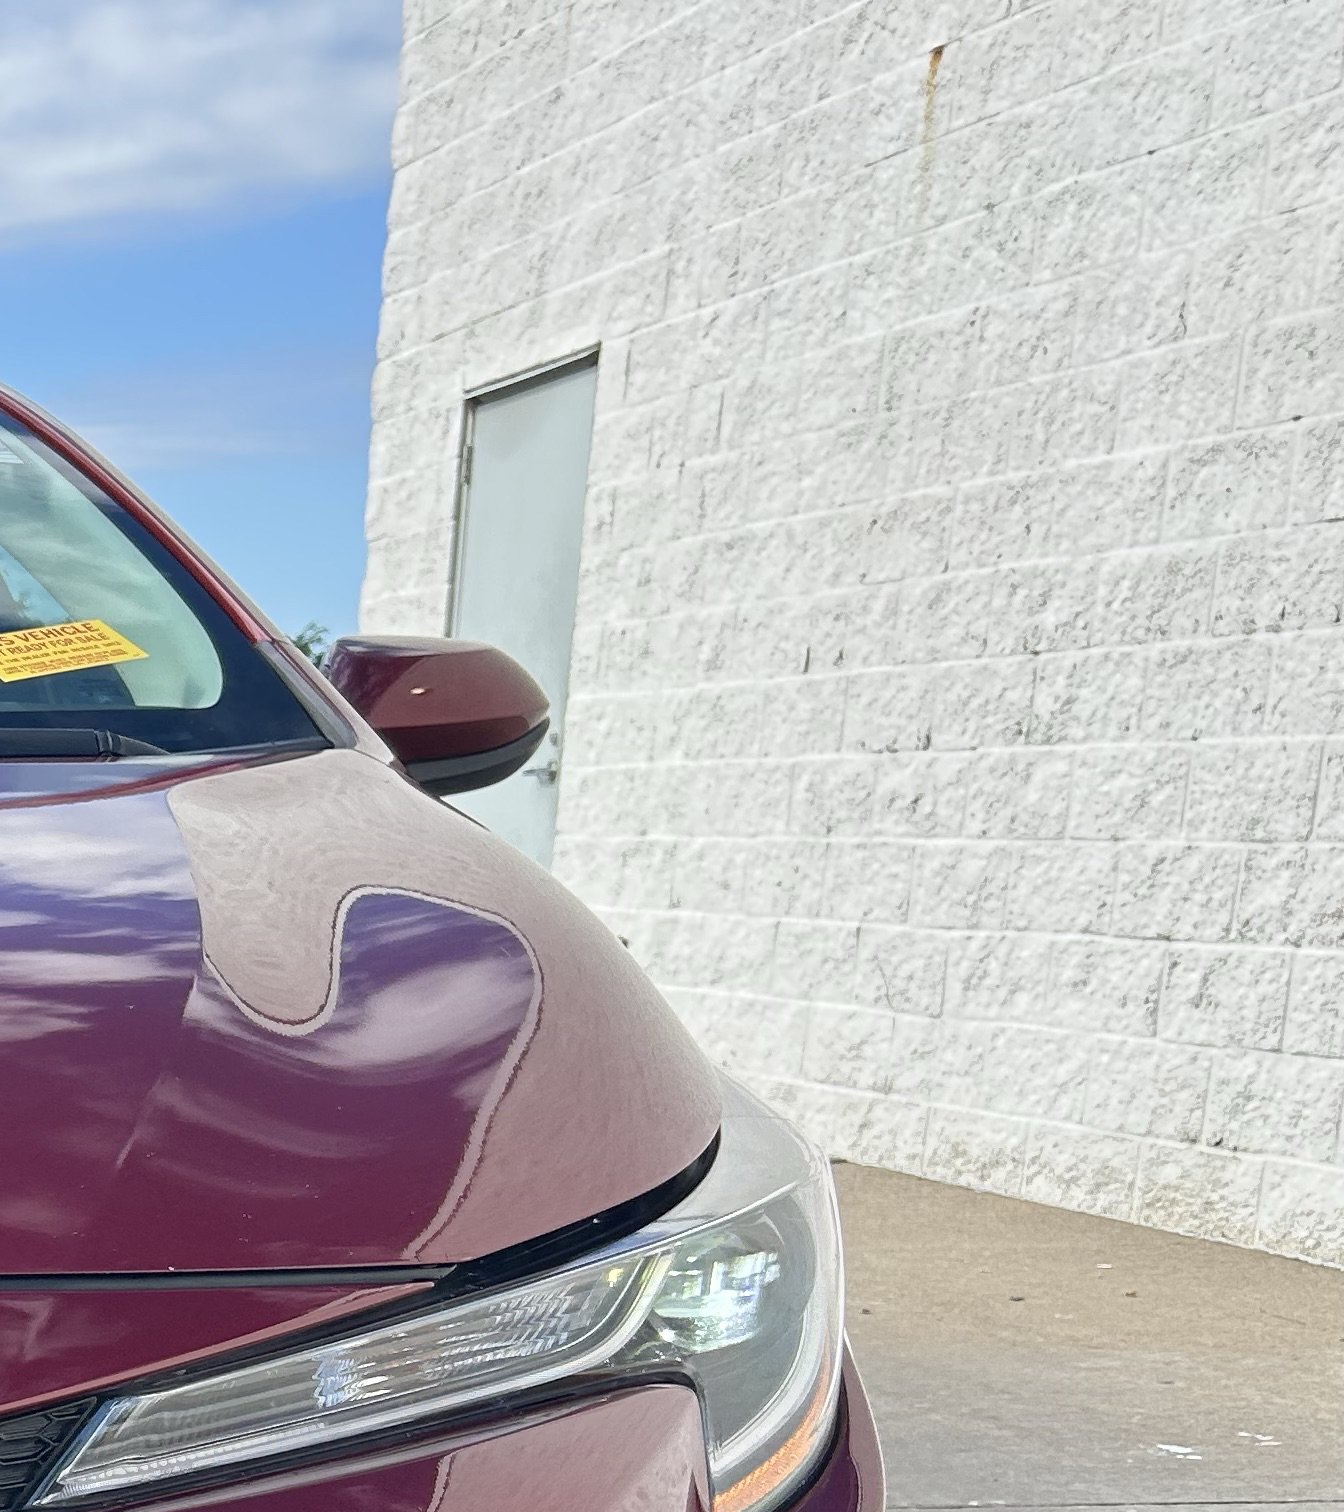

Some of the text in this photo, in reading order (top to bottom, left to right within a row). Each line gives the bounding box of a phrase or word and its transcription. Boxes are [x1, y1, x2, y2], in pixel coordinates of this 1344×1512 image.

[16, 622, 100, 642] VEHICLE
[6, 643, 50, 655] READY
[48, 639, 77, 649] FOR
